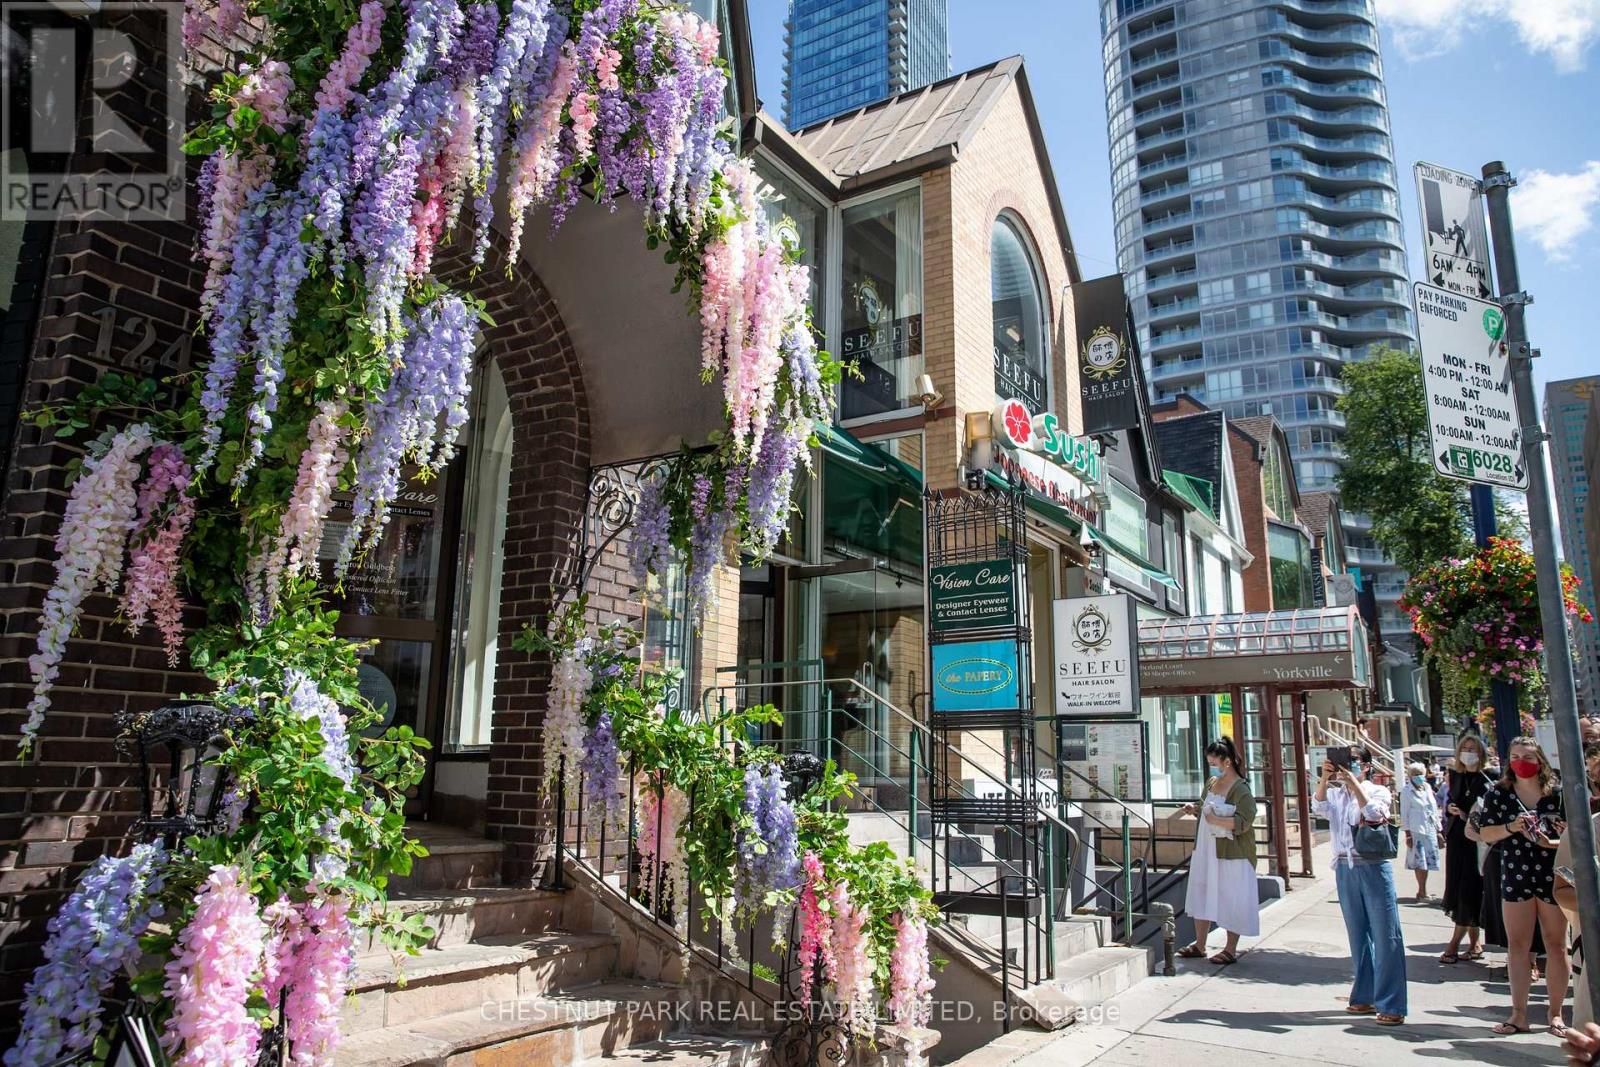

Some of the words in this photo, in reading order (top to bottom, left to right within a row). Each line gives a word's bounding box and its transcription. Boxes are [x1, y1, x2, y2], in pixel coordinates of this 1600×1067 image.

[1421, 165, 1452, 184] LOADING
[1456, 174, 1477, 190] ZONE
[1433, 254, 1453, 273] 6AM
[1466, 262, 1485, 280] 4PM
[1448, 281, 1461, 292] MON
[1466, 285, 1476, 297] FRI
[1418, 288, 1433, 301] PAY
[1435, 294, 1467, 312] PARKING
[1420, 302, 1457, 321] ENFORCED
[91, 307, 192, 375] 124
[844, 321, 920, 352] SEEFU
[993, 346, 1041, 401] SEEFU
[1443, 353, 1466, 369] MON
[1475, 362, 1491, 376] FRI
[1000, 379, 1015, 397] HAIR
[1082, 378, 1130, 396] SEEFU
[1428, 364, 1447, 378] 4:00
[1449, 369, 1463, 383] PM
[1470, 376, 1492, 390] 12:00
[1495, 383, 1508, 395] AM
[1105, 391, 1125, 399] SALON
[1461, 387, 1480, 400] SAT
[1434, 394, 1467, 412] 8:00AM
[1474, 404, 1511, 422] 12:00AM
[1464, 415, 1486, 430] SUN
[1435, 424, 1473, 442] 10:00AM
[1481, 434, 1518, 451] 12:00AM
[1043, 413, 1102, 484] Sushi
[1473, 450, 1513, 473] 6028
[409, 508, 431, 516] Lenses
[932, 571, 972, 590] Vision
[975, 568, 1010, 586] Care
[936, 600, 971, 610] Designer
[974, 597, 1010, 607] Eyewear
[946, 608, 977, 617] Contact
[980, 605, 1008, 614] Lenses
[946, 672, 961, 683] the
[964, 670, 1002, 682] PAPERY
[1059, 660, 1126, 676] SEEFU
[1273, 665, 1333, 679] Yorkville
